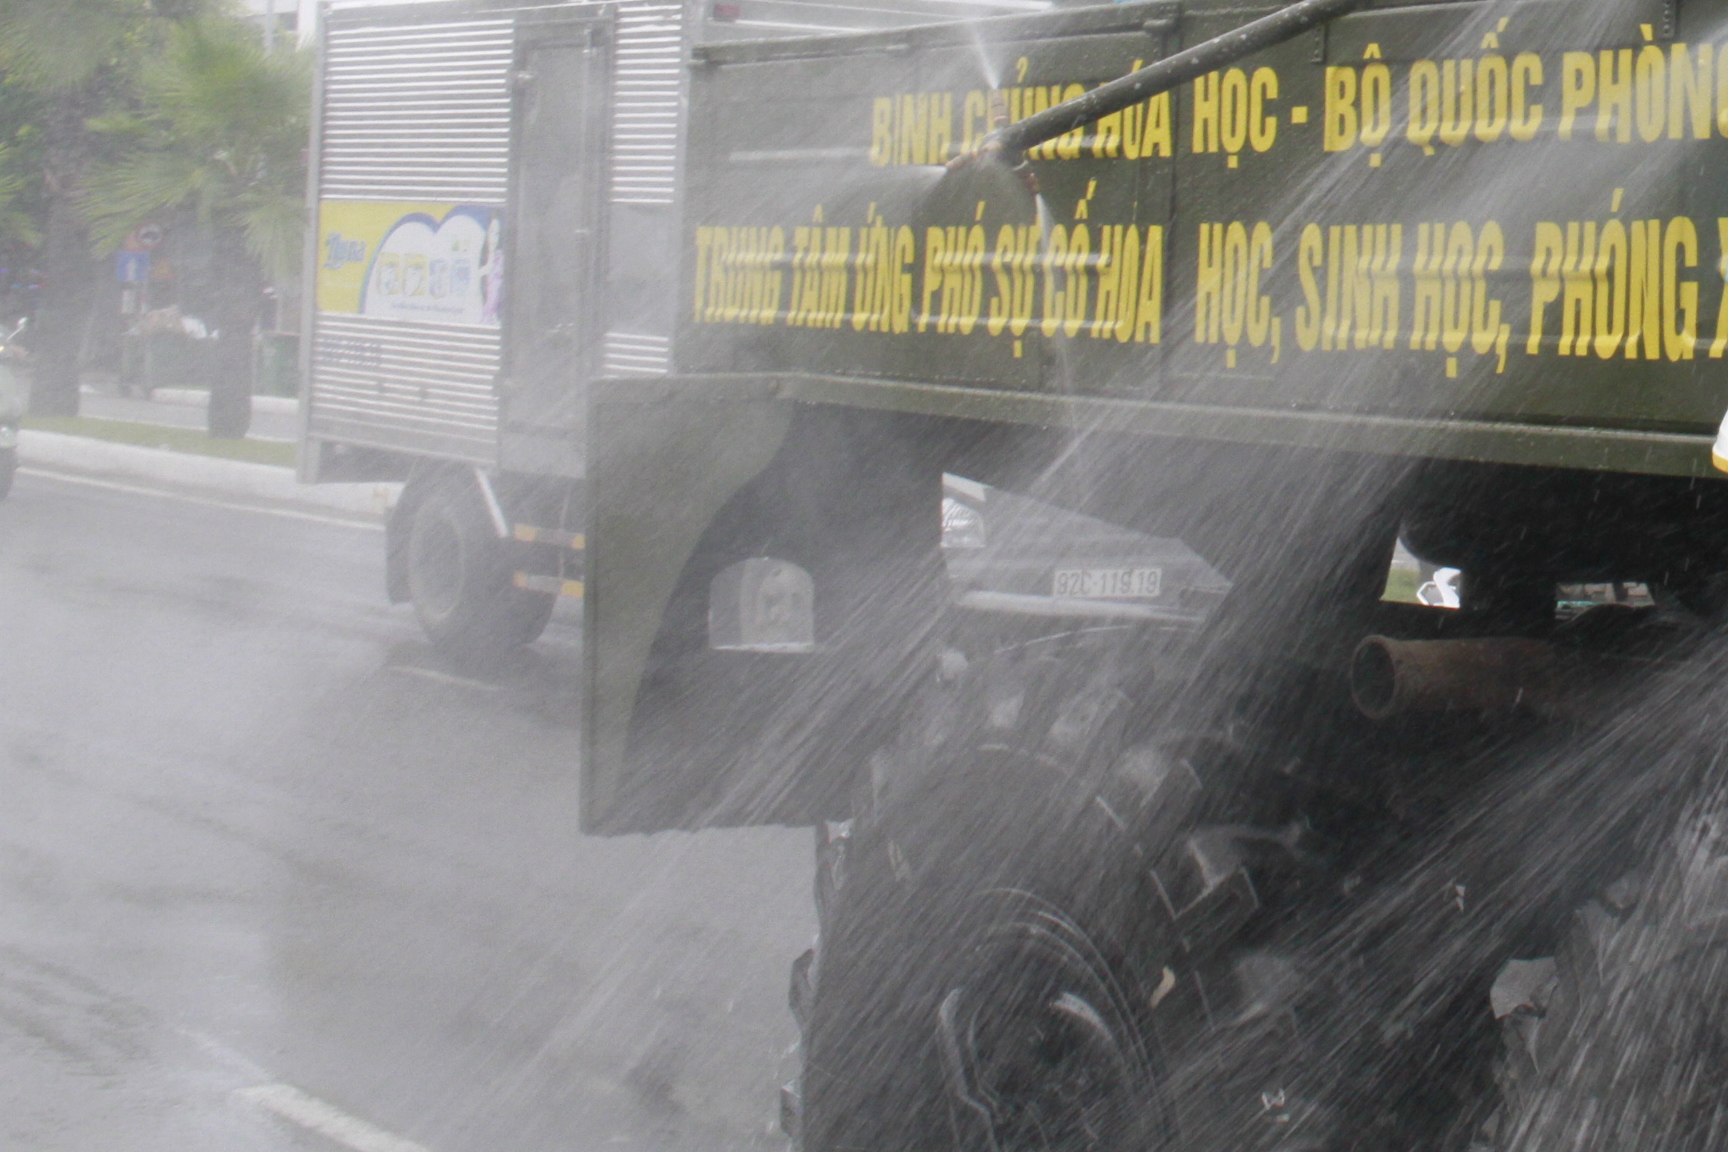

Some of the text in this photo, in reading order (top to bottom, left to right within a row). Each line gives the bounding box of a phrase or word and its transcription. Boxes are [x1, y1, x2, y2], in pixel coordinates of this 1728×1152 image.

[868, 91, 952, 166] BINH
[1192, 67, 1278, 168] HỌC
[1324, 43, 1391, 167] BỘ
[1406, 17, 1543, 156] QUỐC
[695, 224, 784, 325] TRUNG
[787, 204, 851, 329] TÂM
[852, 201, 915, 334] ỨNG
[917, 201, 986, 335] PHÓ
[1041, 180, 1097, 338] CỐ
[1195, 221, 1281, 368] HỌC,
[1295, 222, 1402, 351] SINH
[1409, 221, 1511, 378] HỌC,
[1526, 188, 1699, 362] PHÓNG
